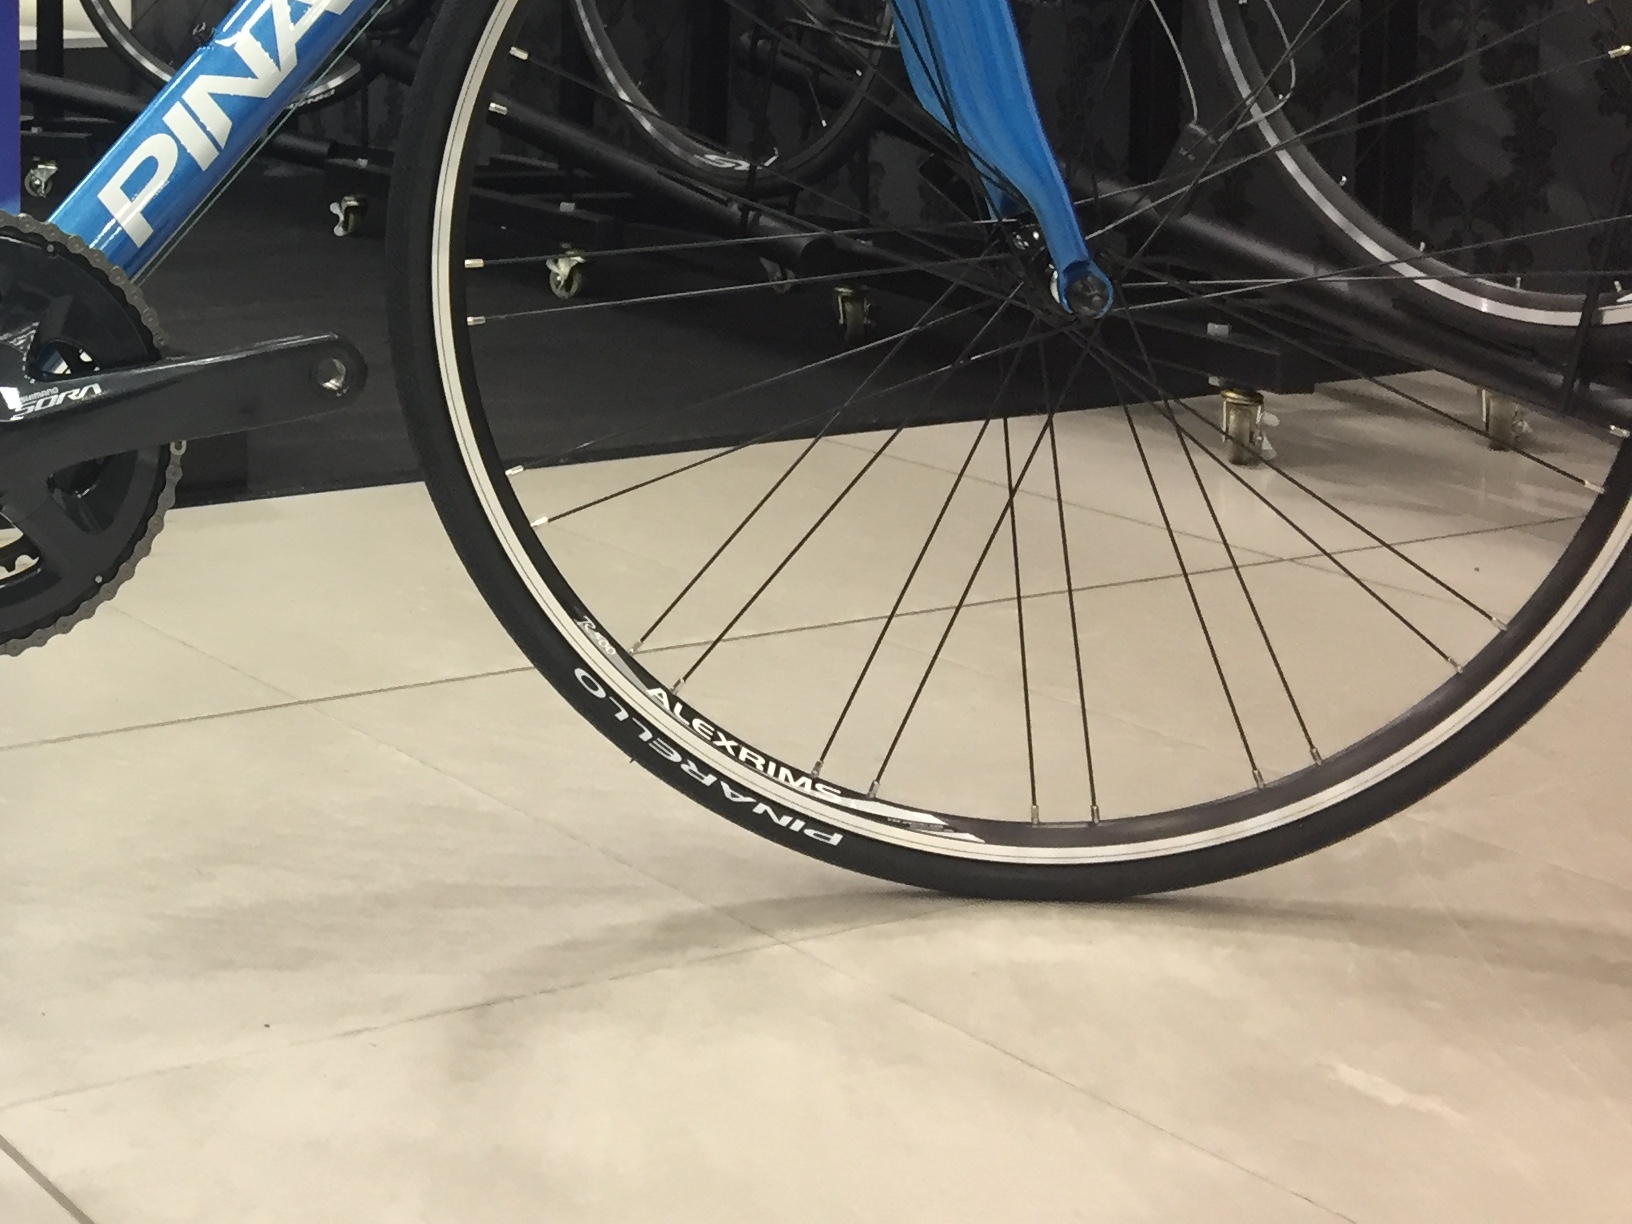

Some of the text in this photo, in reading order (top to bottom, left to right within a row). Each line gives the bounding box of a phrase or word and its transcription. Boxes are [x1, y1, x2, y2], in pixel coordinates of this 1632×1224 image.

[10, 382, 104, 421] SORA
[574, 667, 844, 848] PINARELLO
[646, 687, 843, 802] ALEXRIMS
